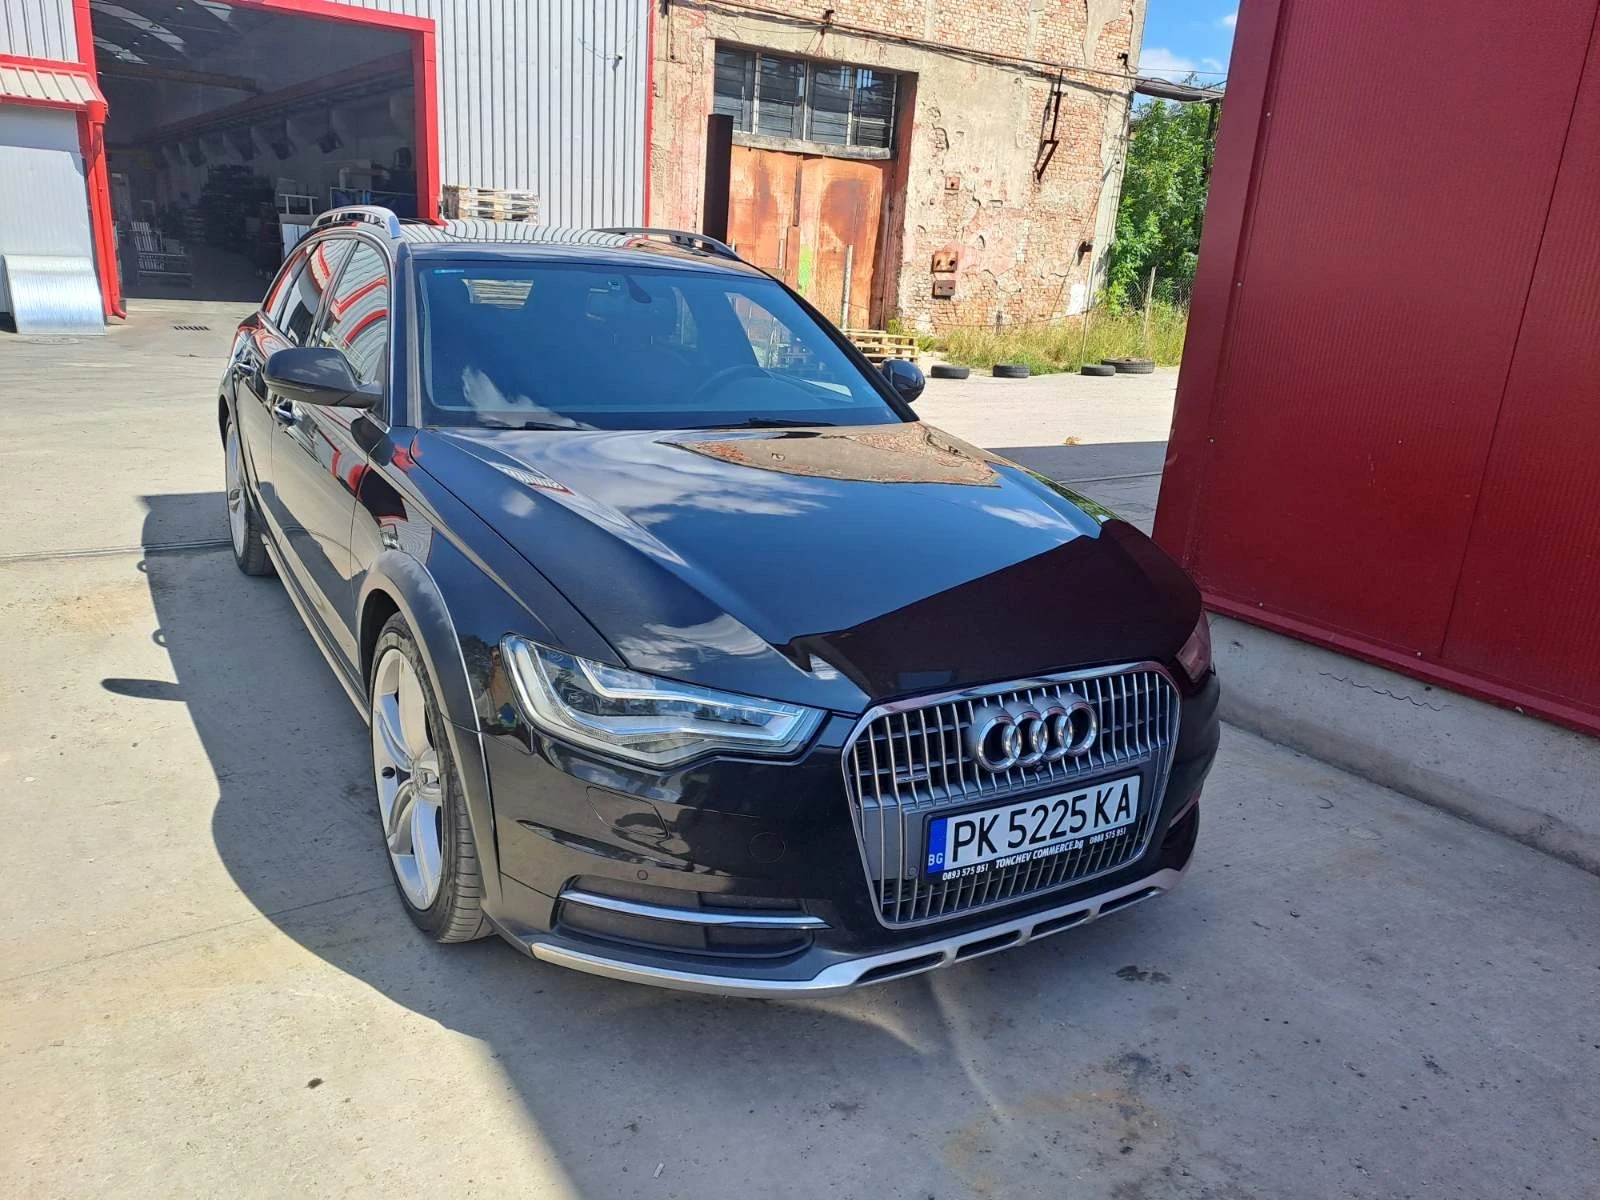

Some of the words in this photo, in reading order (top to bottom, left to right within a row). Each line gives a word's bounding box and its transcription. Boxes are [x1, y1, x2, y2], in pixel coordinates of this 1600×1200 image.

[952, 813, 1001, 863] PK
[1007, 794, 1088, 849] 5225
[1093, 783, 1131, 829] KA
[928, 852, 944, 866] BG
[995, 851, 1032, 869] TONCHEV
